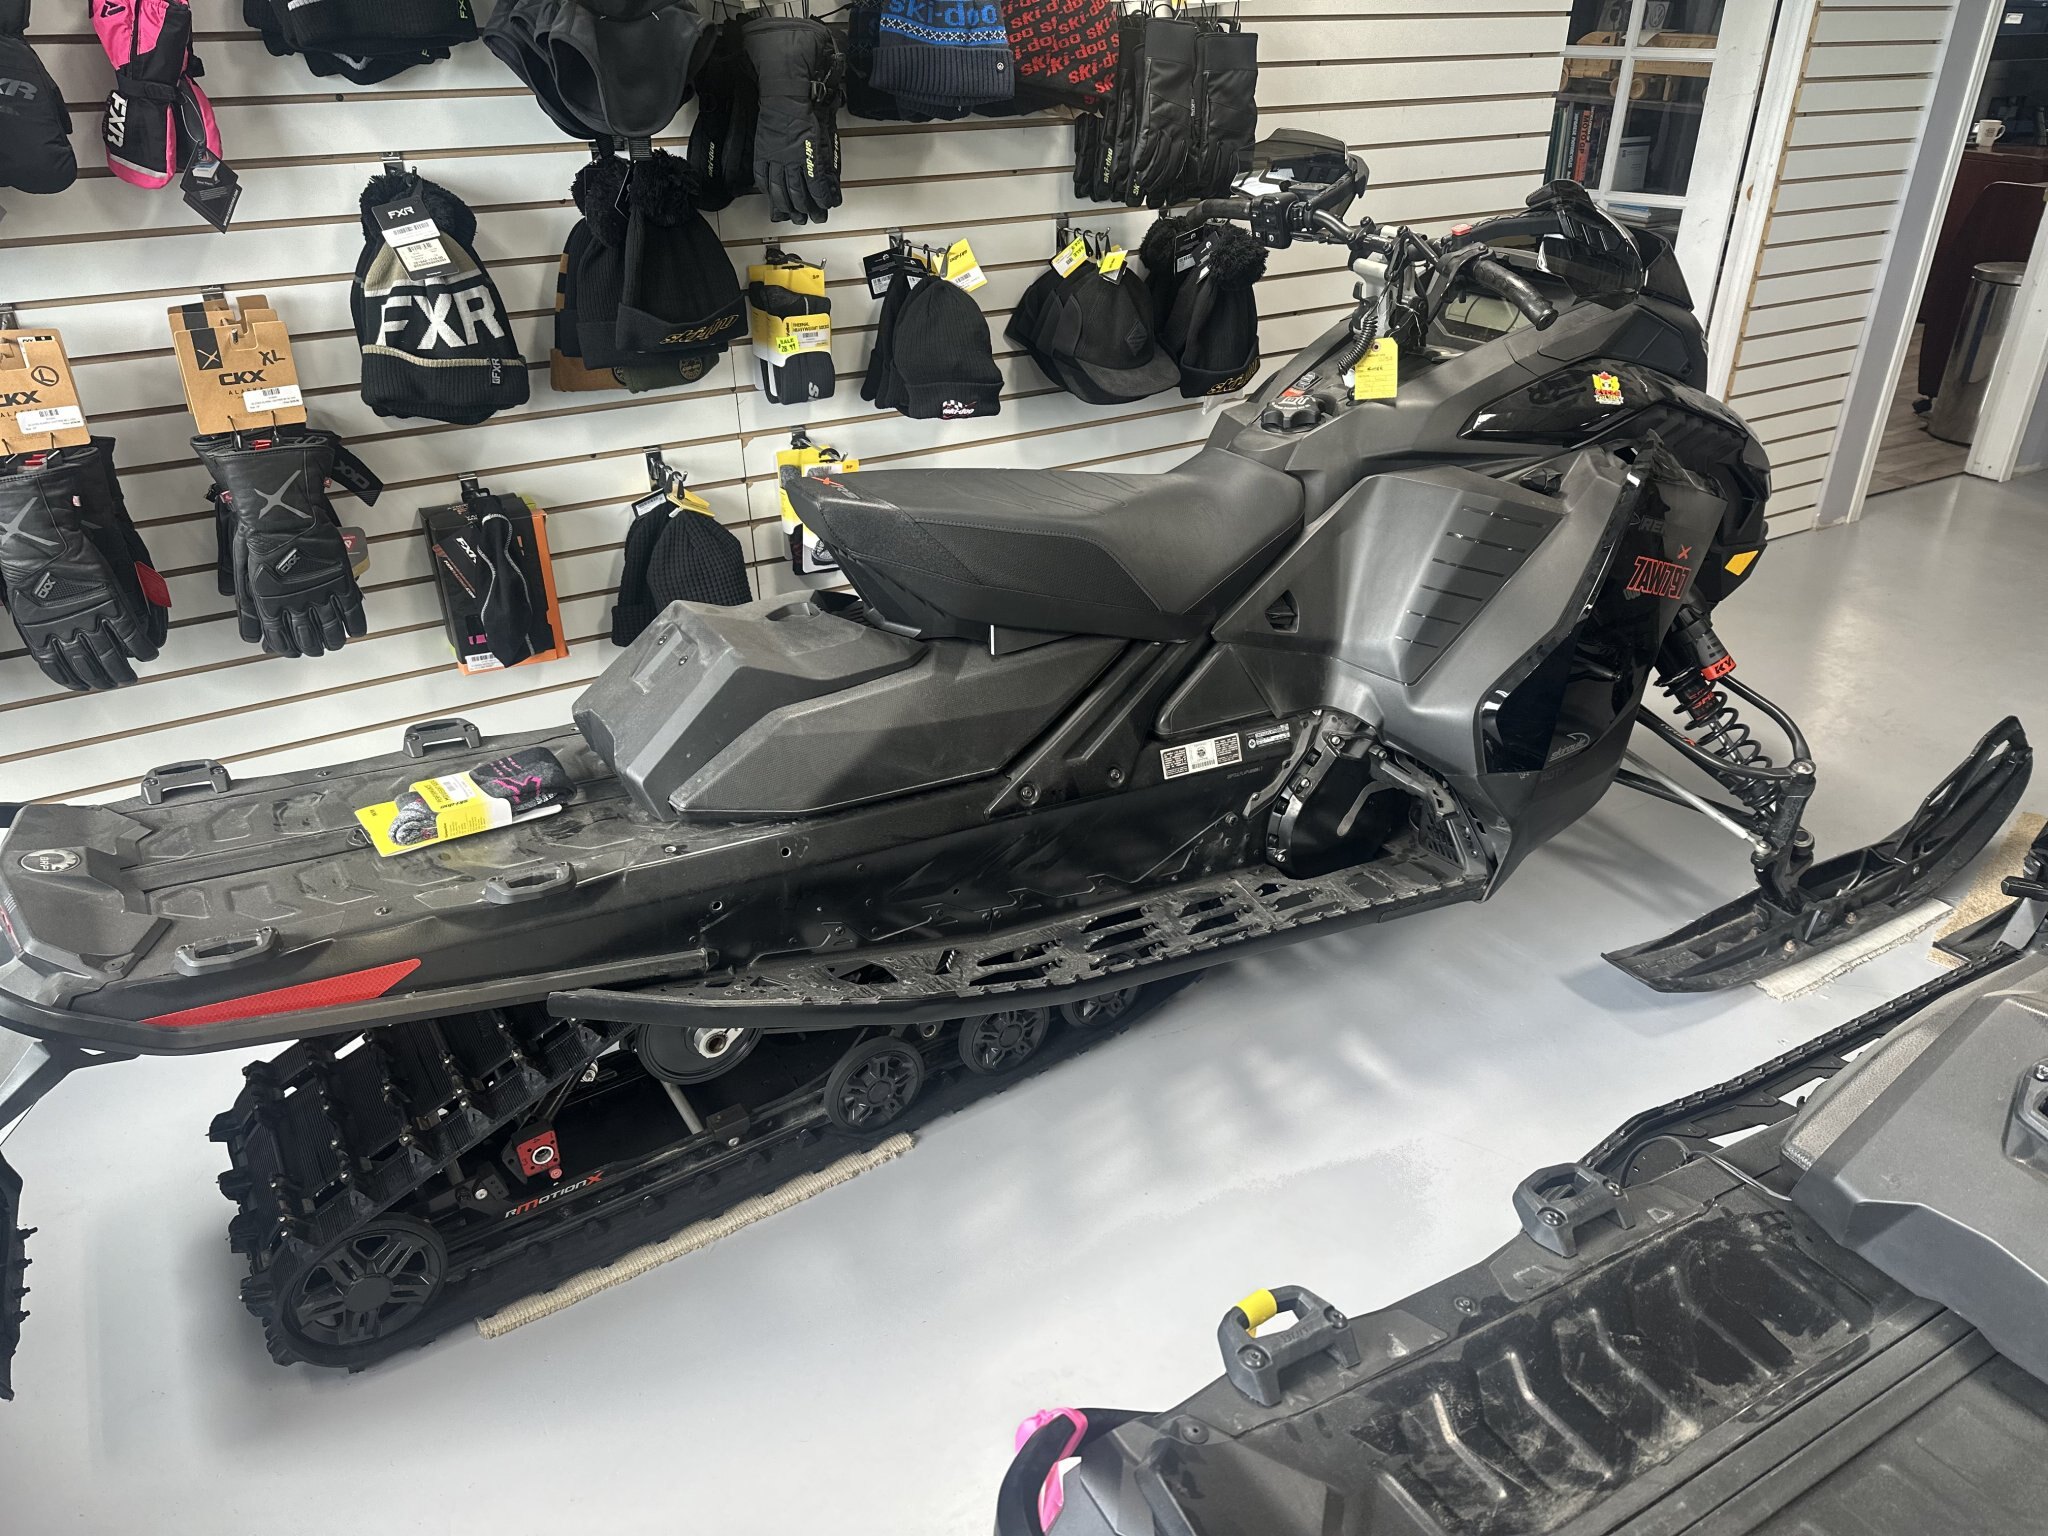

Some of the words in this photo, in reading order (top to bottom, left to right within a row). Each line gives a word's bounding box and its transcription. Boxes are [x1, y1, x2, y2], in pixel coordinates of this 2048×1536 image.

[888, 0, 998, 26] ski-doo
[107, 91, 128, 148] FXR
[804, 139, 815, 178] ski-doo
[1103, 147, 1114, 184] ski-doo
[388, 206, 415, 220] FXR
[376, 285, 505, 350] FXR
[780, 337, 794, 345] SALE
[258, 349, 286, 366] XL
[218, 369, 267, 386] CKX
[492, 358, 501, 379] FXR
[281, 554, 300, 574] CKX
[1626, 555, 1692, 600] 7AW797
[38, 579, 56, 599] CKX
[39, 857, 49, 871] BRP
